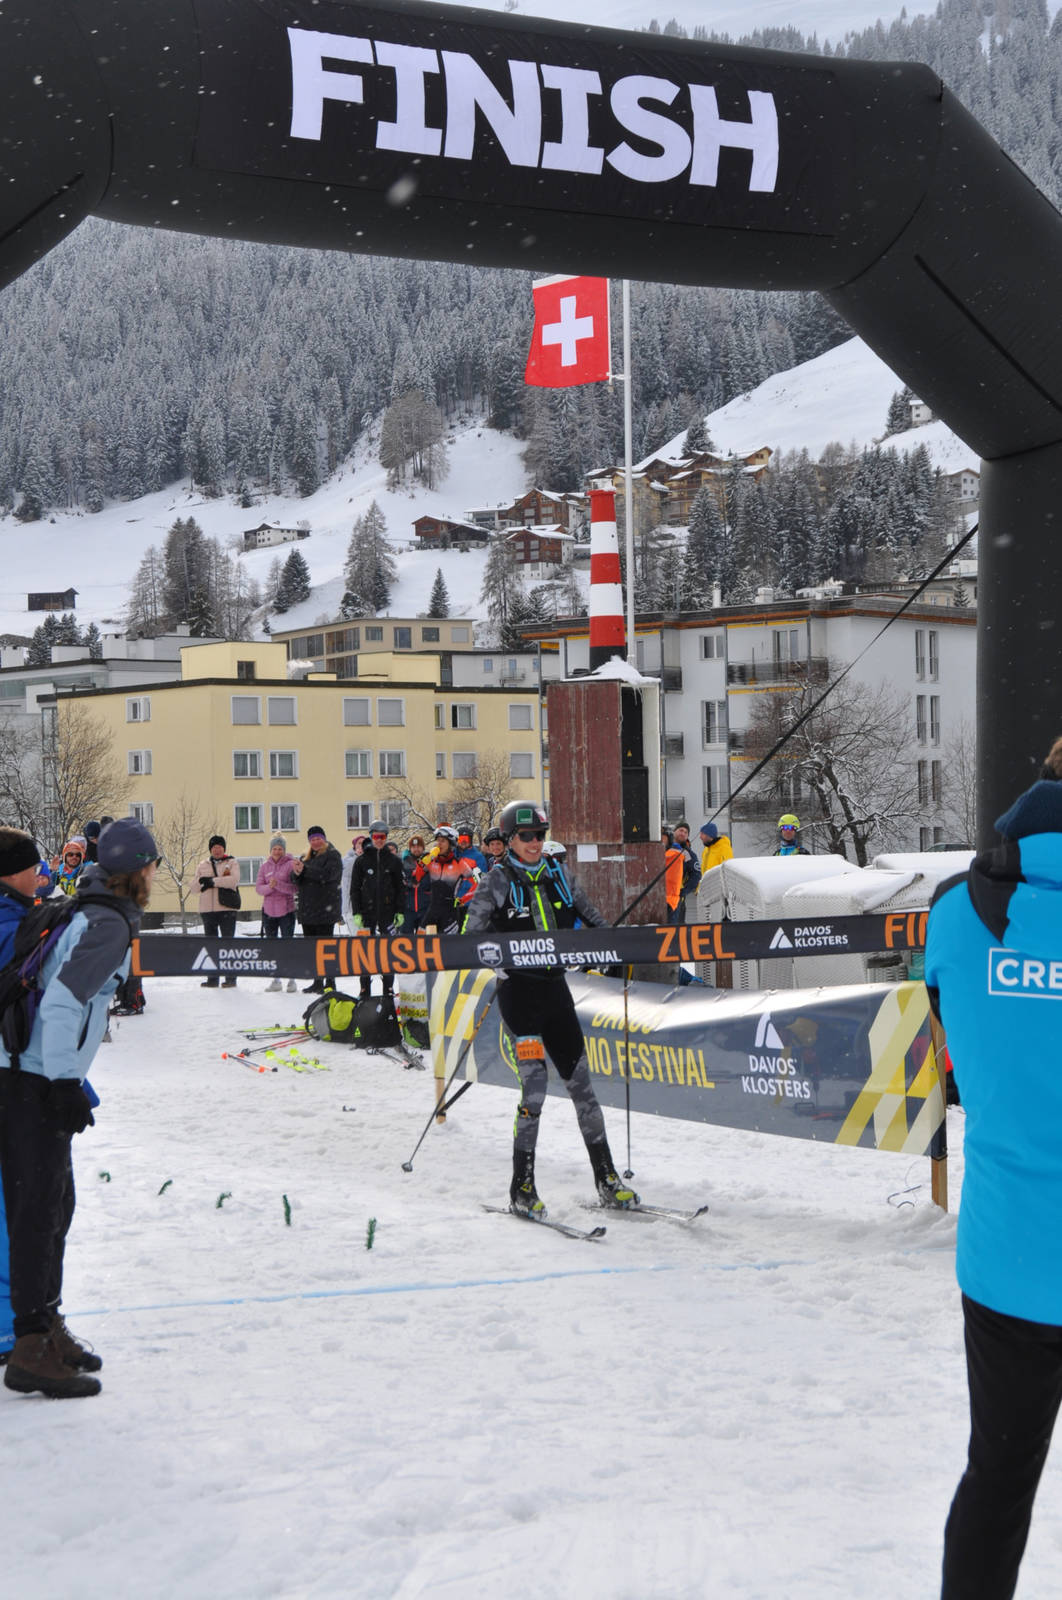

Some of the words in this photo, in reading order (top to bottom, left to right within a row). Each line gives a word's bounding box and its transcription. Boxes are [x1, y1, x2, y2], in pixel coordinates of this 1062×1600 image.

[287, 27, 779, 192] FINISH
[794, 925, 831, 938] DAVOS
[794, 935, 848, 948] KLOSTERS
[509, 938, 555, 954] DAVOS
[655, 925, 736, 962] ZIEL
[219, 948, 260, 960] DAVOS
[316, 937, 444, 976] FINISH
[513, 952, 557, 967] SKIMO
[560, 950, 622, 965] FESTIVAL
[219, 959, 277, 971] KLOSTERS
[615, 1040, 716, 1089] FESTIVAL
[749, 1054, 796, 1077] DAVOS
[741, 1075, 811, 1099] KLOSTERS
